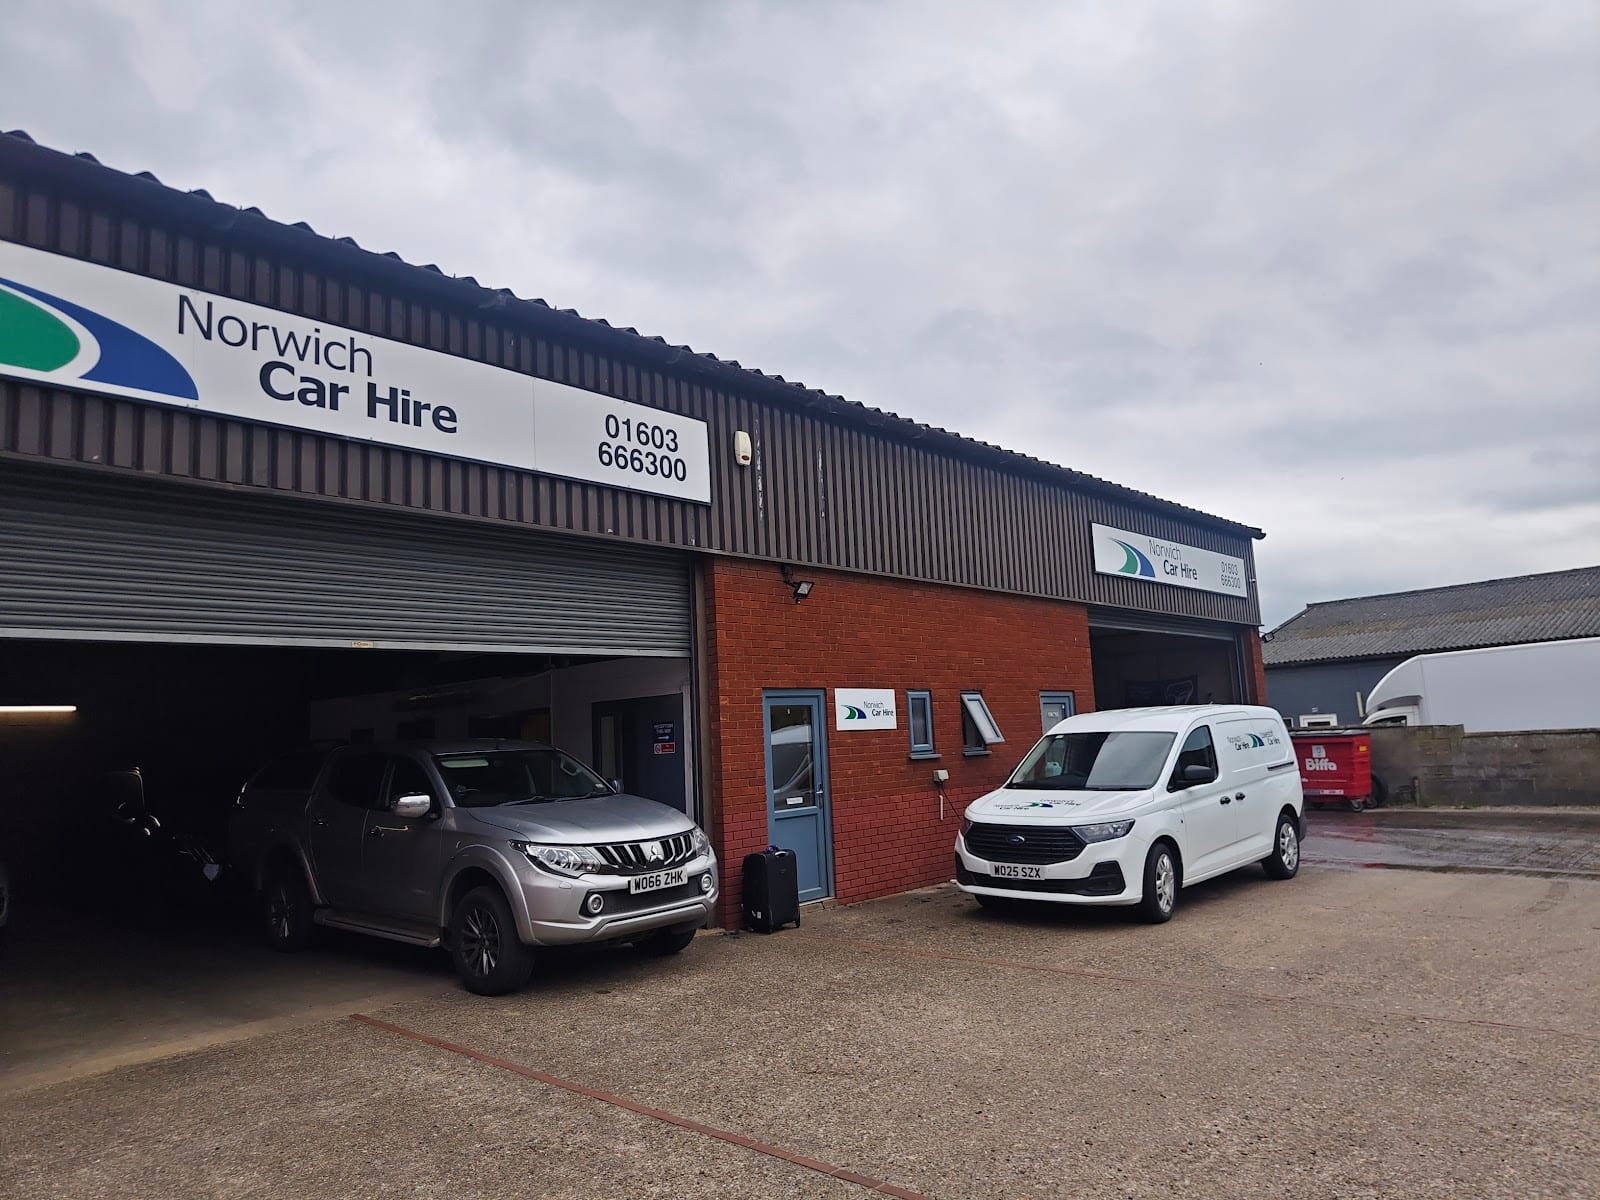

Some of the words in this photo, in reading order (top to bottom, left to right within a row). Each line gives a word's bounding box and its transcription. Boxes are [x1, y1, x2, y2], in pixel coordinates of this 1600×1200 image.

[177, 294, 373, 378] Norwich
[259, 360, 350, 412] Car
[366, 381, 458, 434] Hire
[605, 413, 679, 453] 01603
[598, 441, 687, 482] 666300
[1149, 539, 1181, 560] Norwich
[1163, 560, 1178, 576] Car
[1180, 562, 1198, 580] Hire
[863, 700, 884, 709] Norwich
[871, 708, 881, 717] Car
[882, 708, 895, 717] Hire
[1305, 758, 1337, 771] Biffa
[664, 869, 684, 886] ZHK
[1021, 867, 1041, 879] SZX
